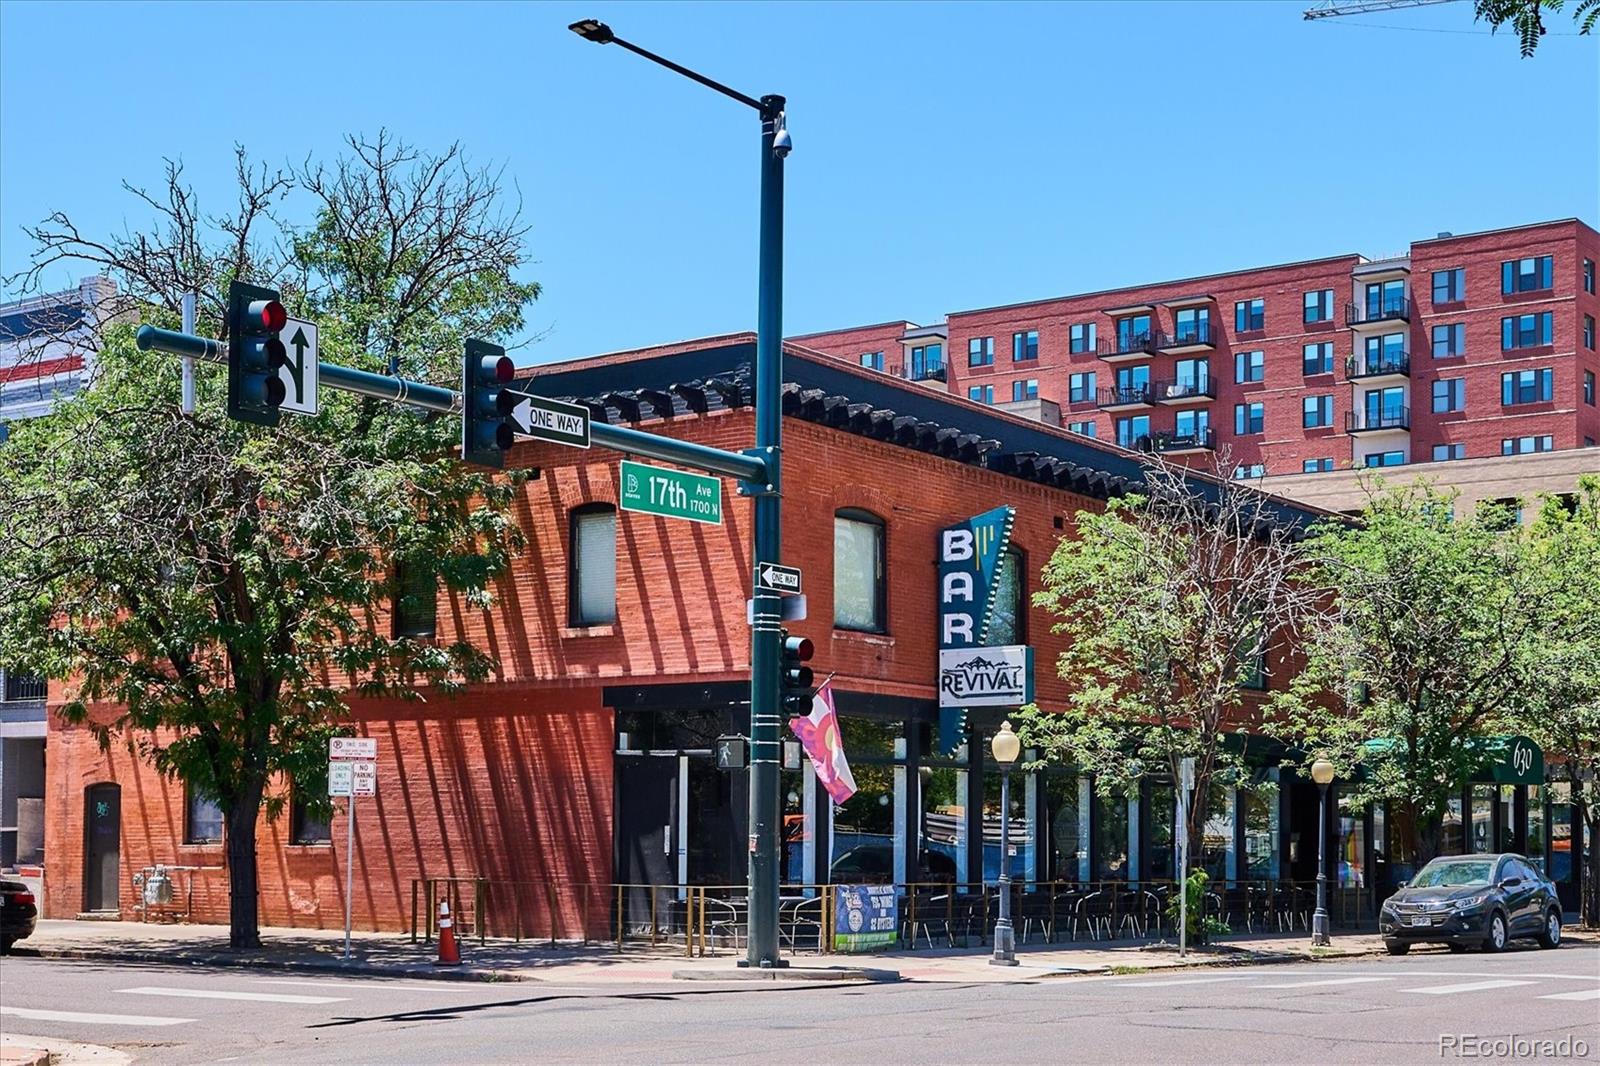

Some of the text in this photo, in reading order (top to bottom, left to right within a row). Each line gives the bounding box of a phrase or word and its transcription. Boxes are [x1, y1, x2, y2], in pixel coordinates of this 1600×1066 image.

[530, 410, 581, 433] ONE WAY
[649, 476, 686, 510] 17th
[696, 483, 712, 498] Ave
[690, 500, 718, 516] 1700 N
[771, 572, 783, 583] ONE
[943, 529, 974, 644] BAR
[1513, 740, 1533, 776] 630
